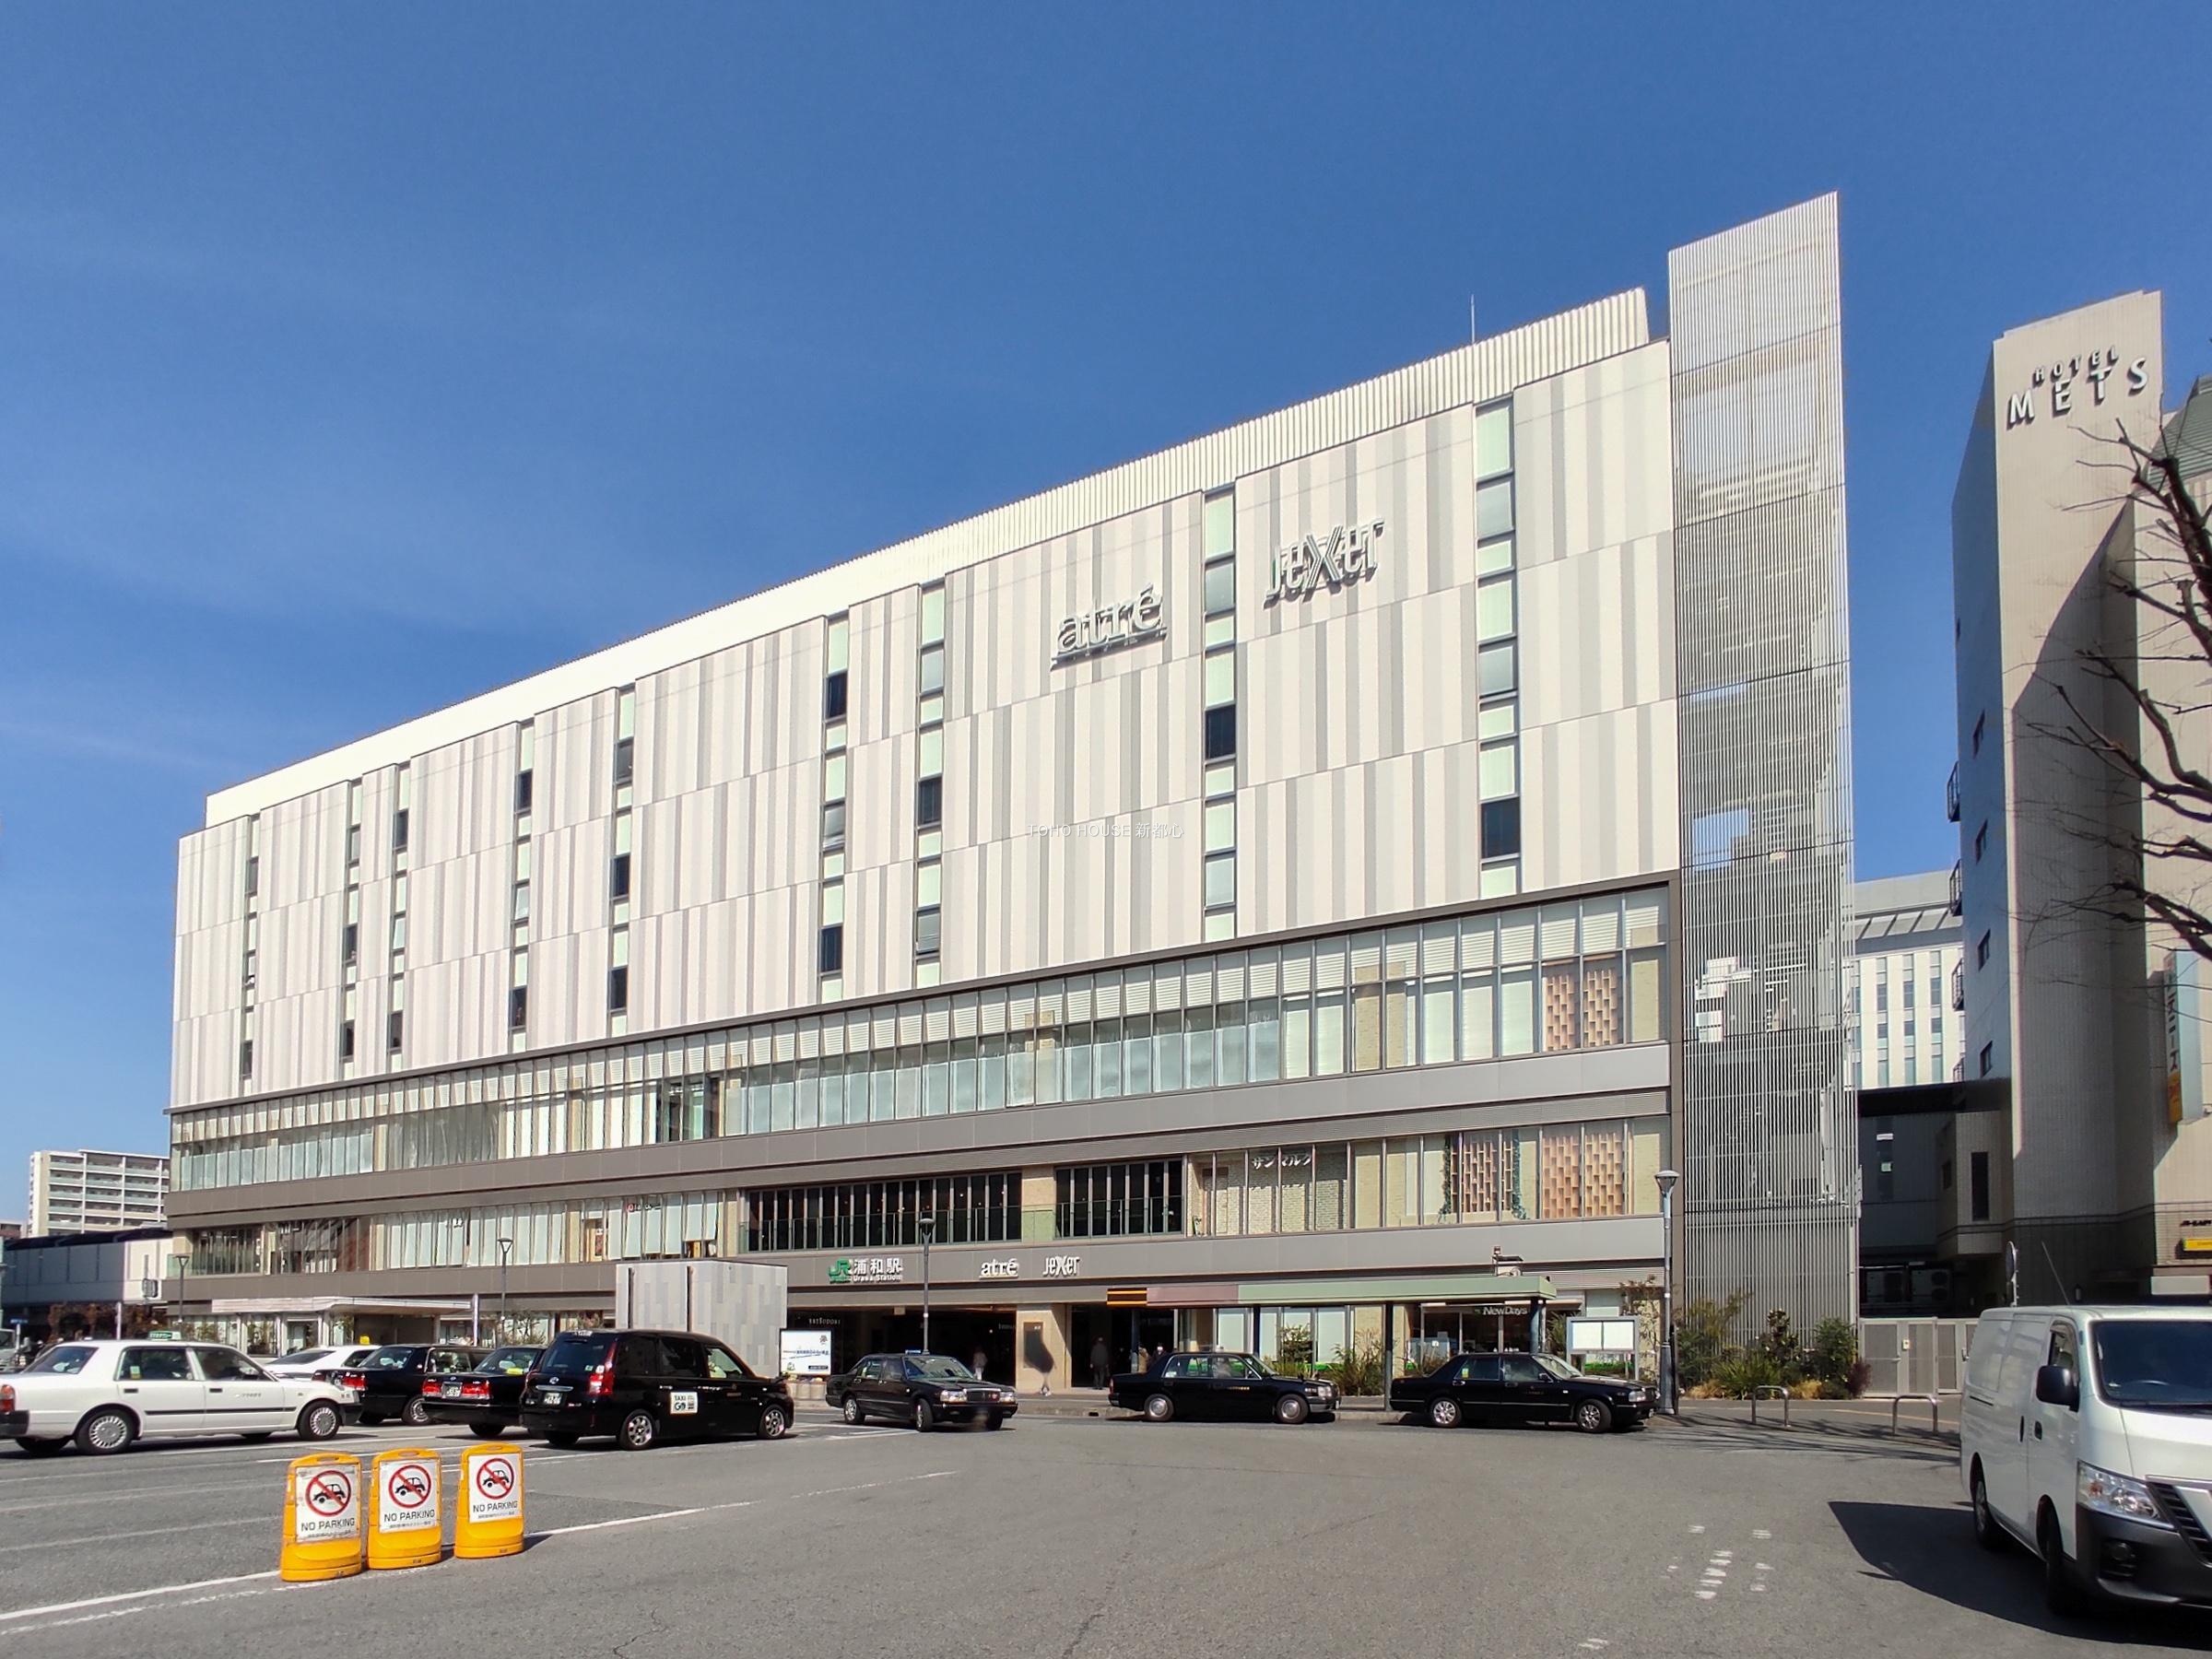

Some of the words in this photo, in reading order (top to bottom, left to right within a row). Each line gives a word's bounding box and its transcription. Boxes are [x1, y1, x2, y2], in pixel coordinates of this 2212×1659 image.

[2033, 345, 2119, 383] HOTEL
[2008, 357, 2148, 425] METS
[828, 1259, 853, 1277] JR
[853, 1258, 903, 1276] 浦和駅
[980, 1258, 1019, 1277] atré
[1482, 1306, 1528, 1316] NewDays
[473, 1503, 485, 1513] NO
[487, 1500, 518, 1512] PARKING
[300, 1521, 316, 1532] NO
[318, 1516, 356, 1530] PARKING
[383, 1512, 397, 1523] NO
[399, 1509, 435, 1522] PARKING
